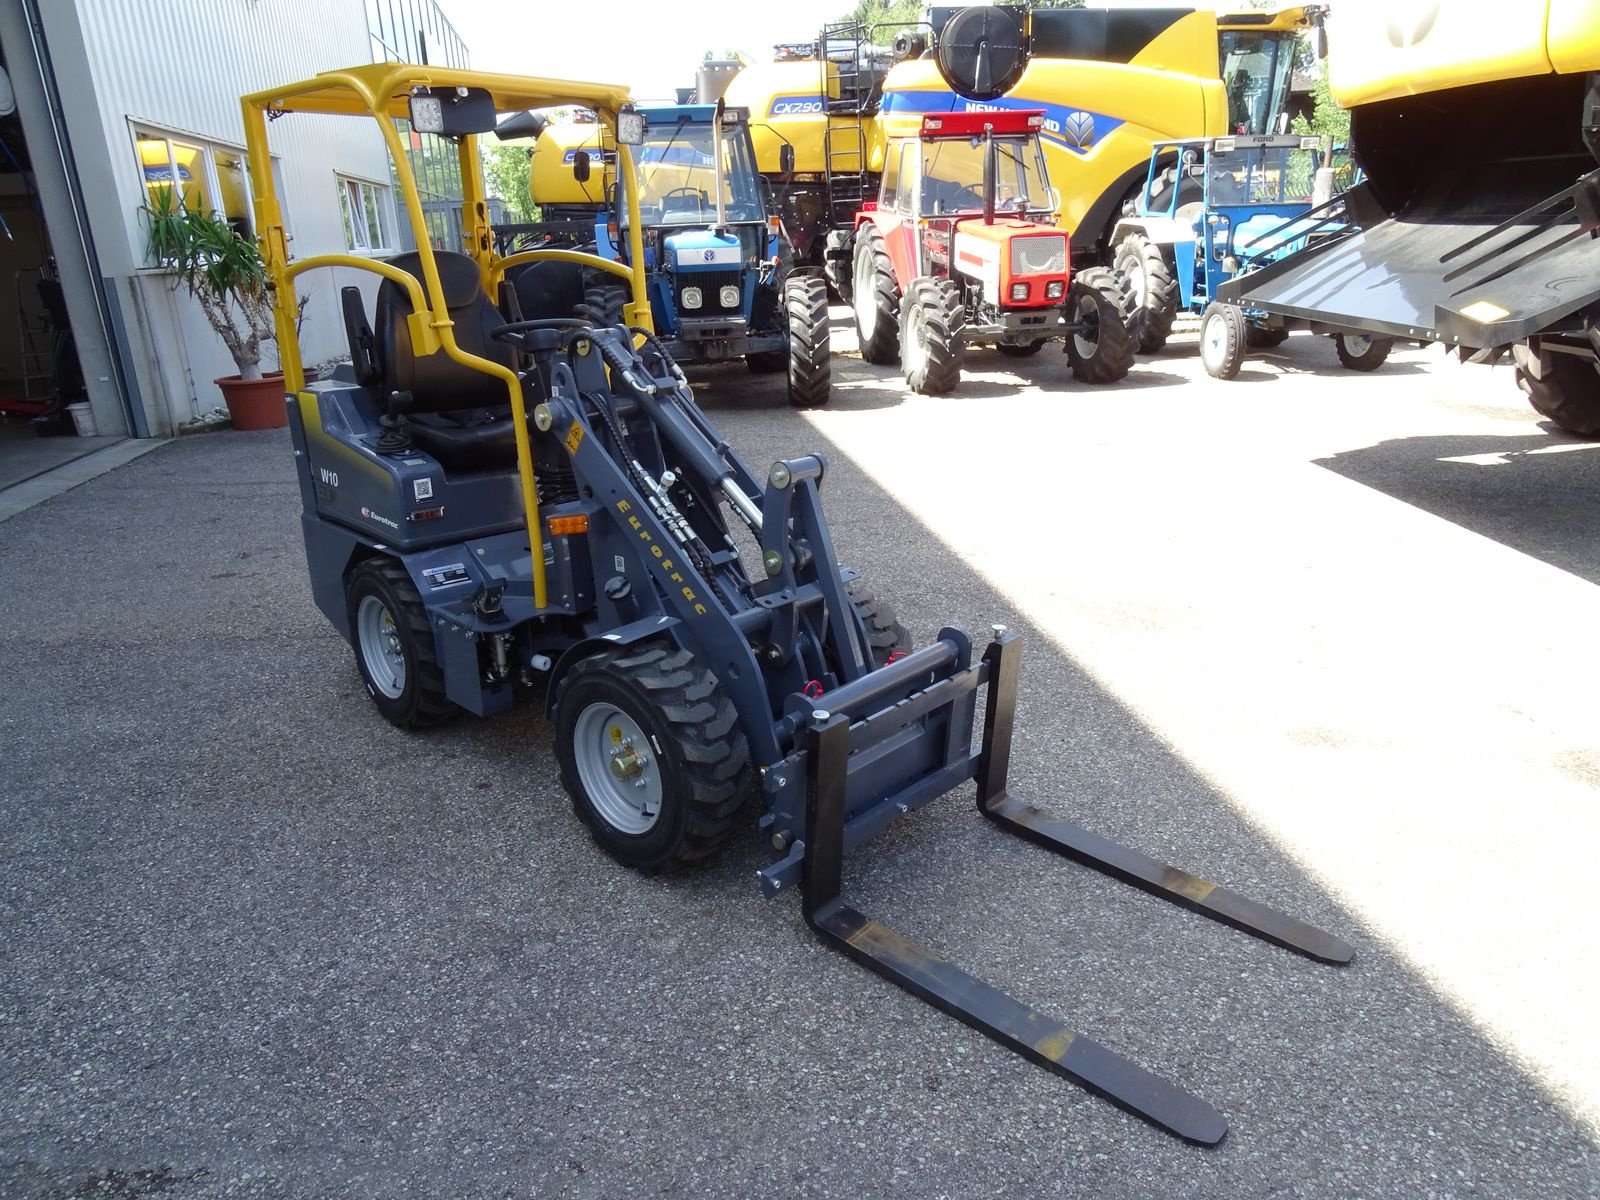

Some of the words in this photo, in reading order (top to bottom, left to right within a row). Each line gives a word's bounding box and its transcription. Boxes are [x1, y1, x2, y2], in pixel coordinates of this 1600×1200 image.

[320, 467, 339, 488] W10
[370, 511, 399, 530] Eurotrac
[616, 499, 707, 616] Eurotrac
